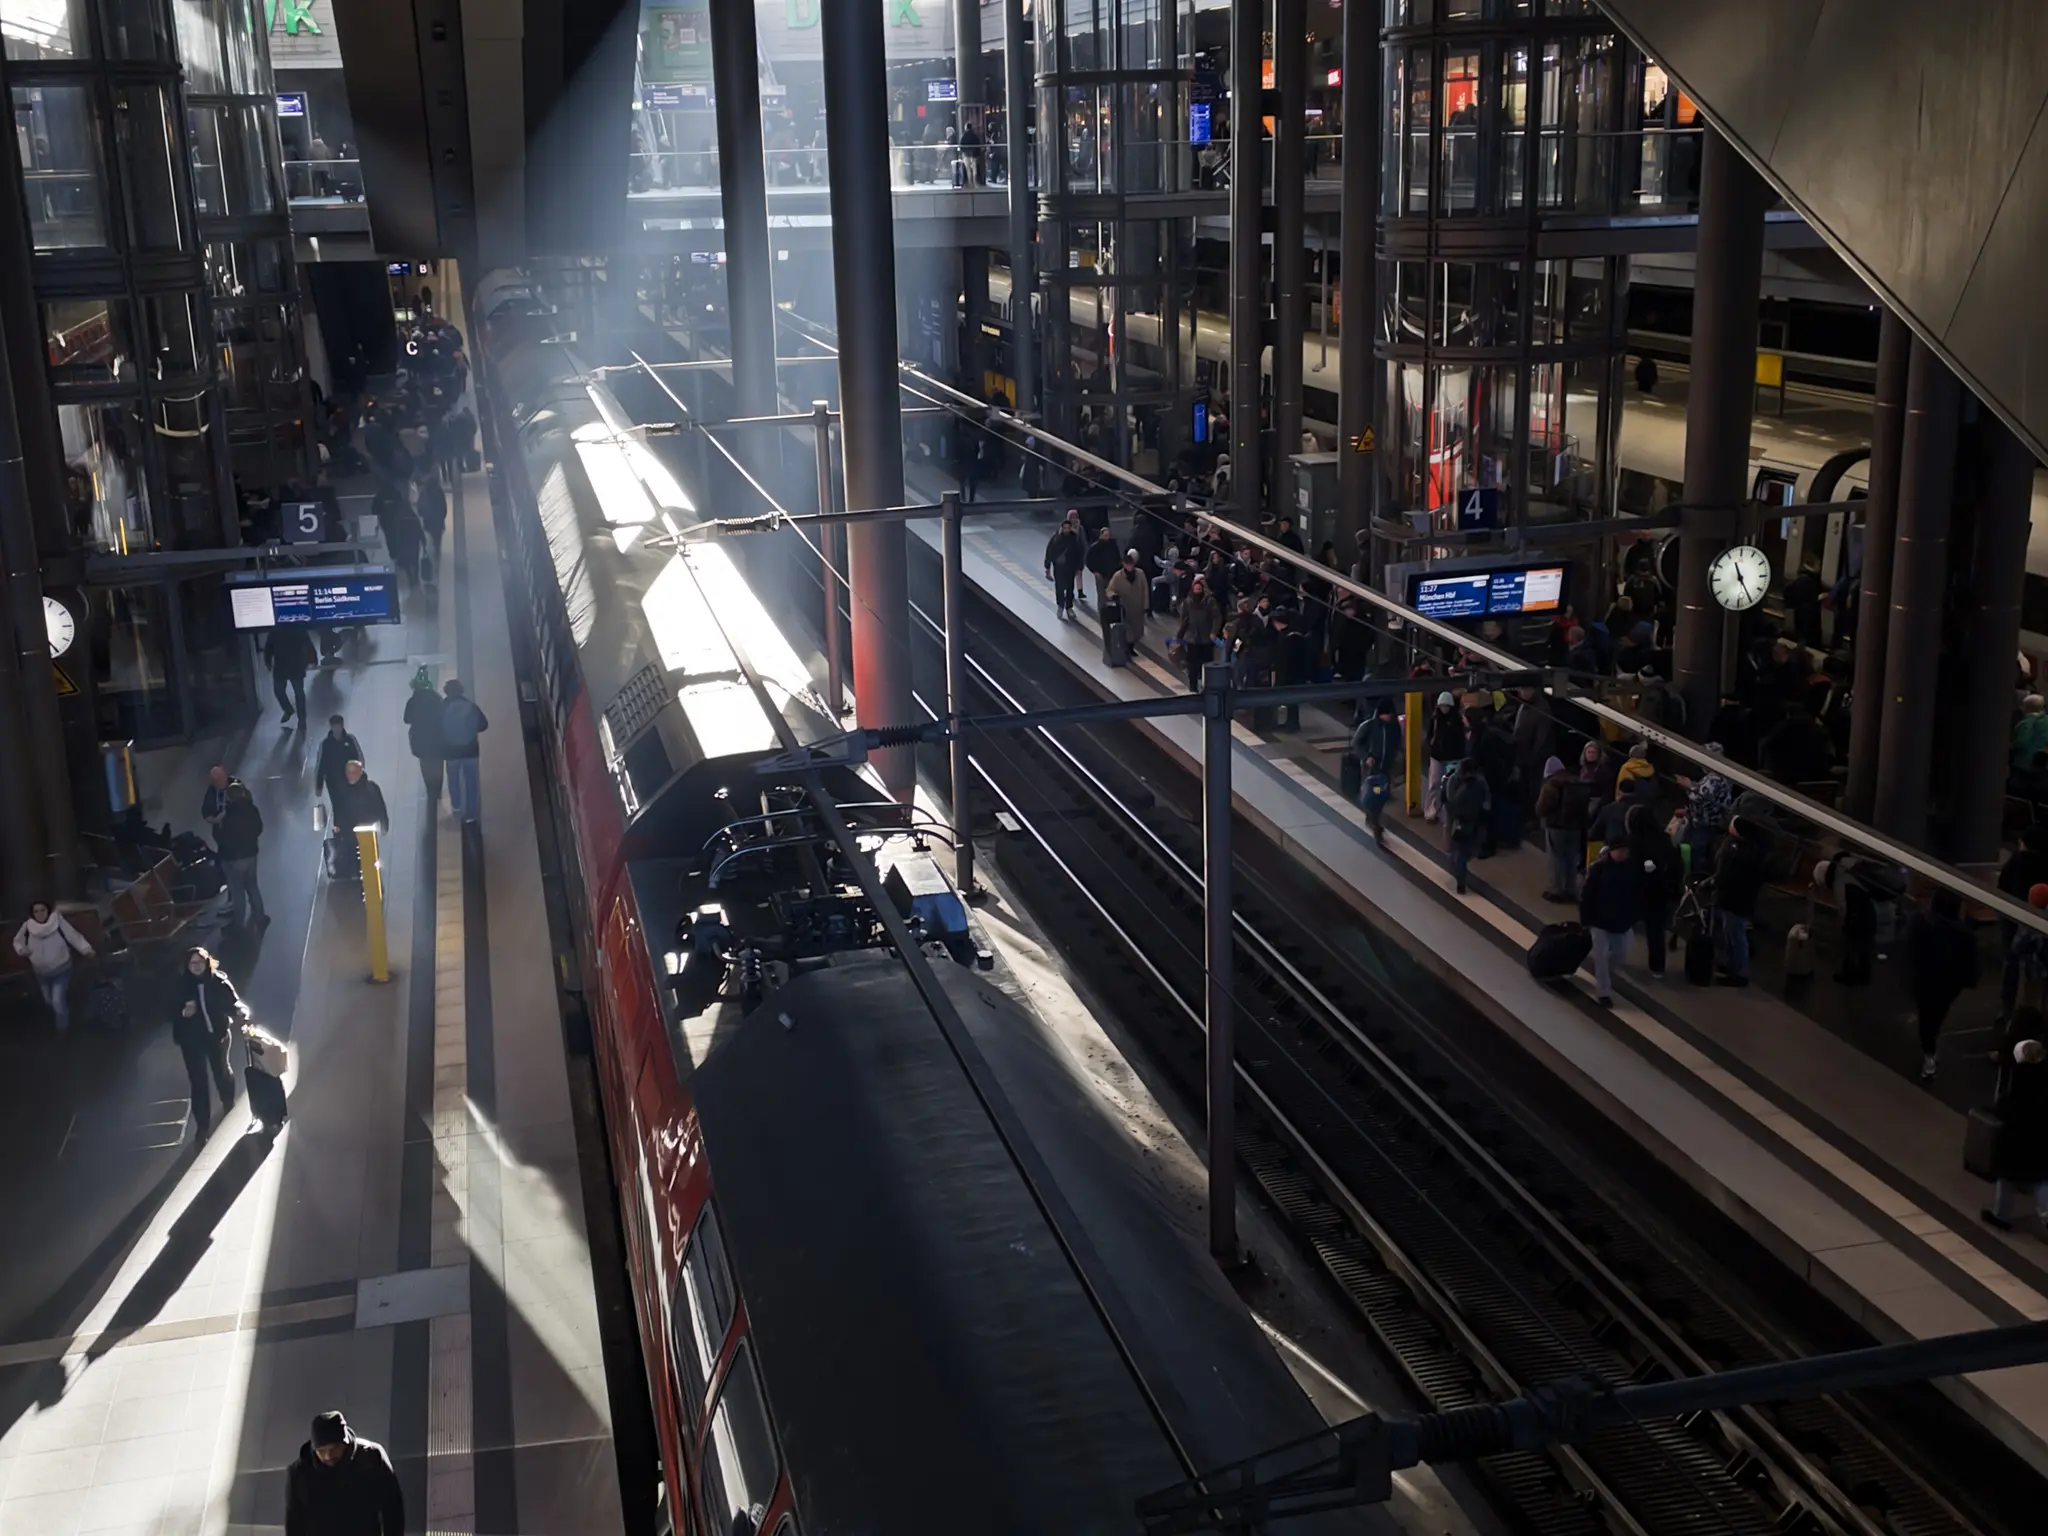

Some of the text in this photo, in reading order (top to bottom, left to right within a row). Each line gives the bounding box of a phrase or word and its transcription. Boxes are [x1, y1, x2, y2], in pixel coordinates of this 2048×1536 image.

[406, 341, 418, 355] C
[1464, 490, 1484, 521] 4
[299, 504, 318, 533] 5
[314, 588, 332, 596] 11:14
[1420, 584, 1438, 593] 11:27
[314, 596, 333, 604] Berlin
[1419, 593, 1445, 602] München
[1445, 591, 1457, 599] Hbf
